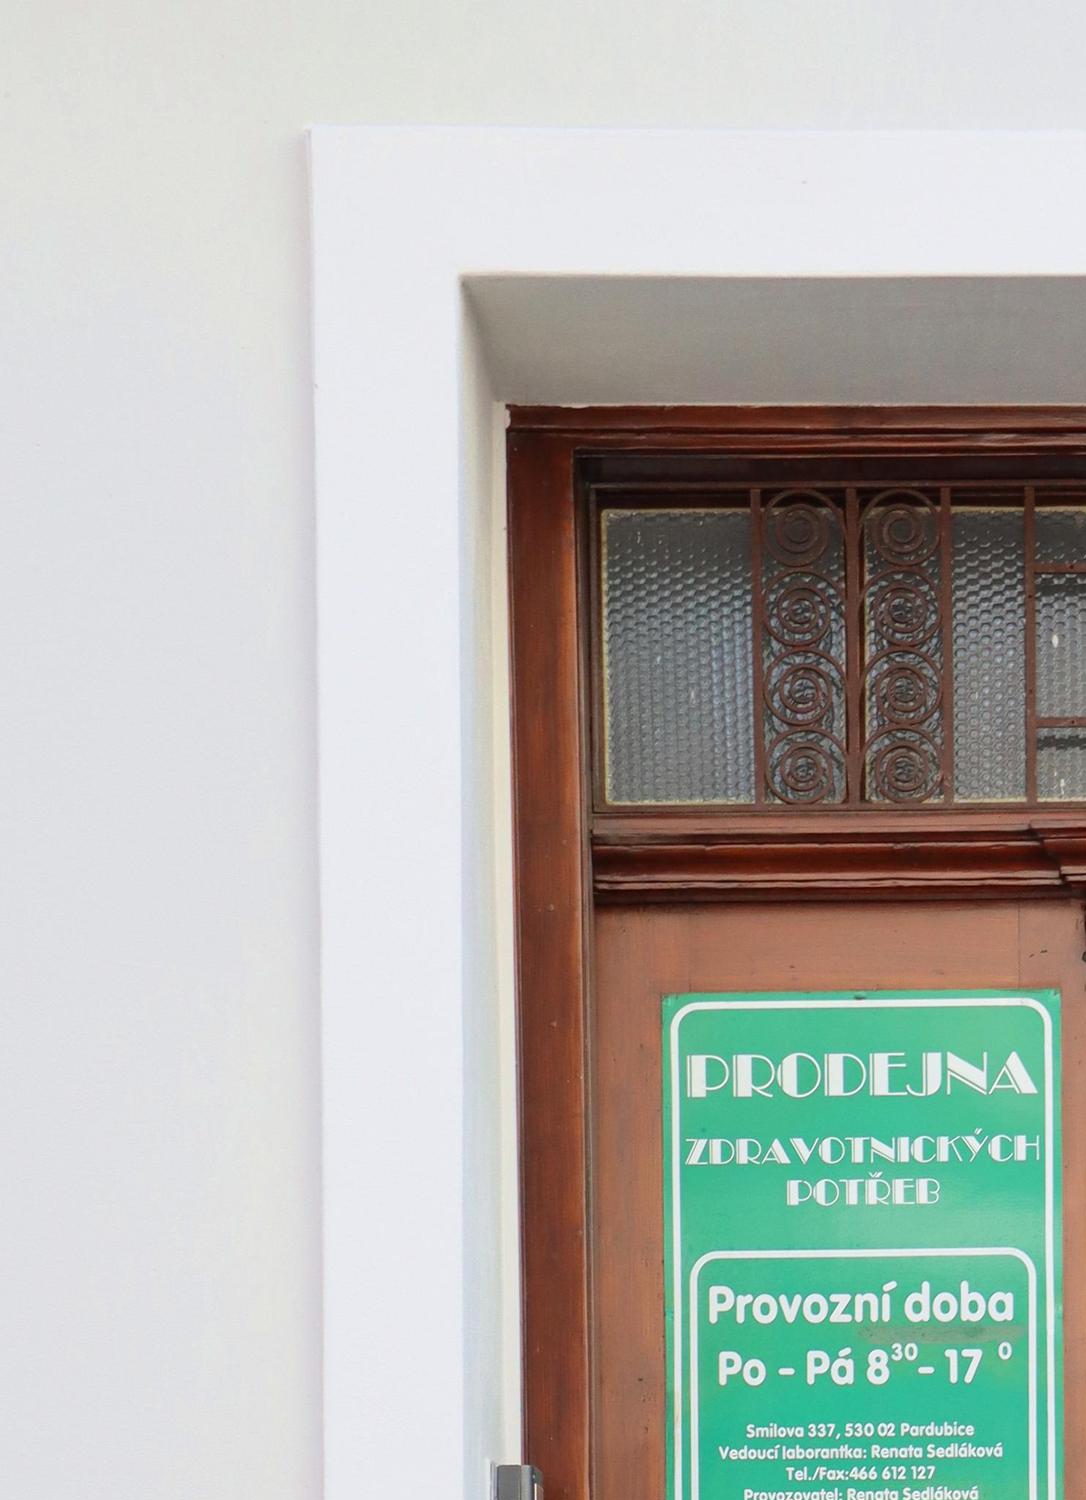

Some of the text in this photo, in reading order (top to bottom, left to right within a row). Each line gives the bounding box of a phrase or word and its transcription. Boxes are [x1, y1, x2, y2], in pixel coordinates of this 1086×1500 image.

[687, 1051, 1038, 1098] PRODEJNA
[685, 1127, 1040, 1166] ZDRAVOTNICKÝCH
[787, 1171, 940, 1206] POTŘEB
[709, 1280, 1014, 1324] Provozní doba
[718, 1351, 766, 1386] Po
[806, 1348, 855, 1385] Pá
[746, 1421, 974, 1439] Smilova 337, 530 02 Pardubice
[719, 1442, 1002, 1460] Vedoucí laborantka: Renata Sedláková
[786, 1466, 935, 1481] Tel./Fax:466 612 127
[903, 1486, 978, 1500] Sedláková
